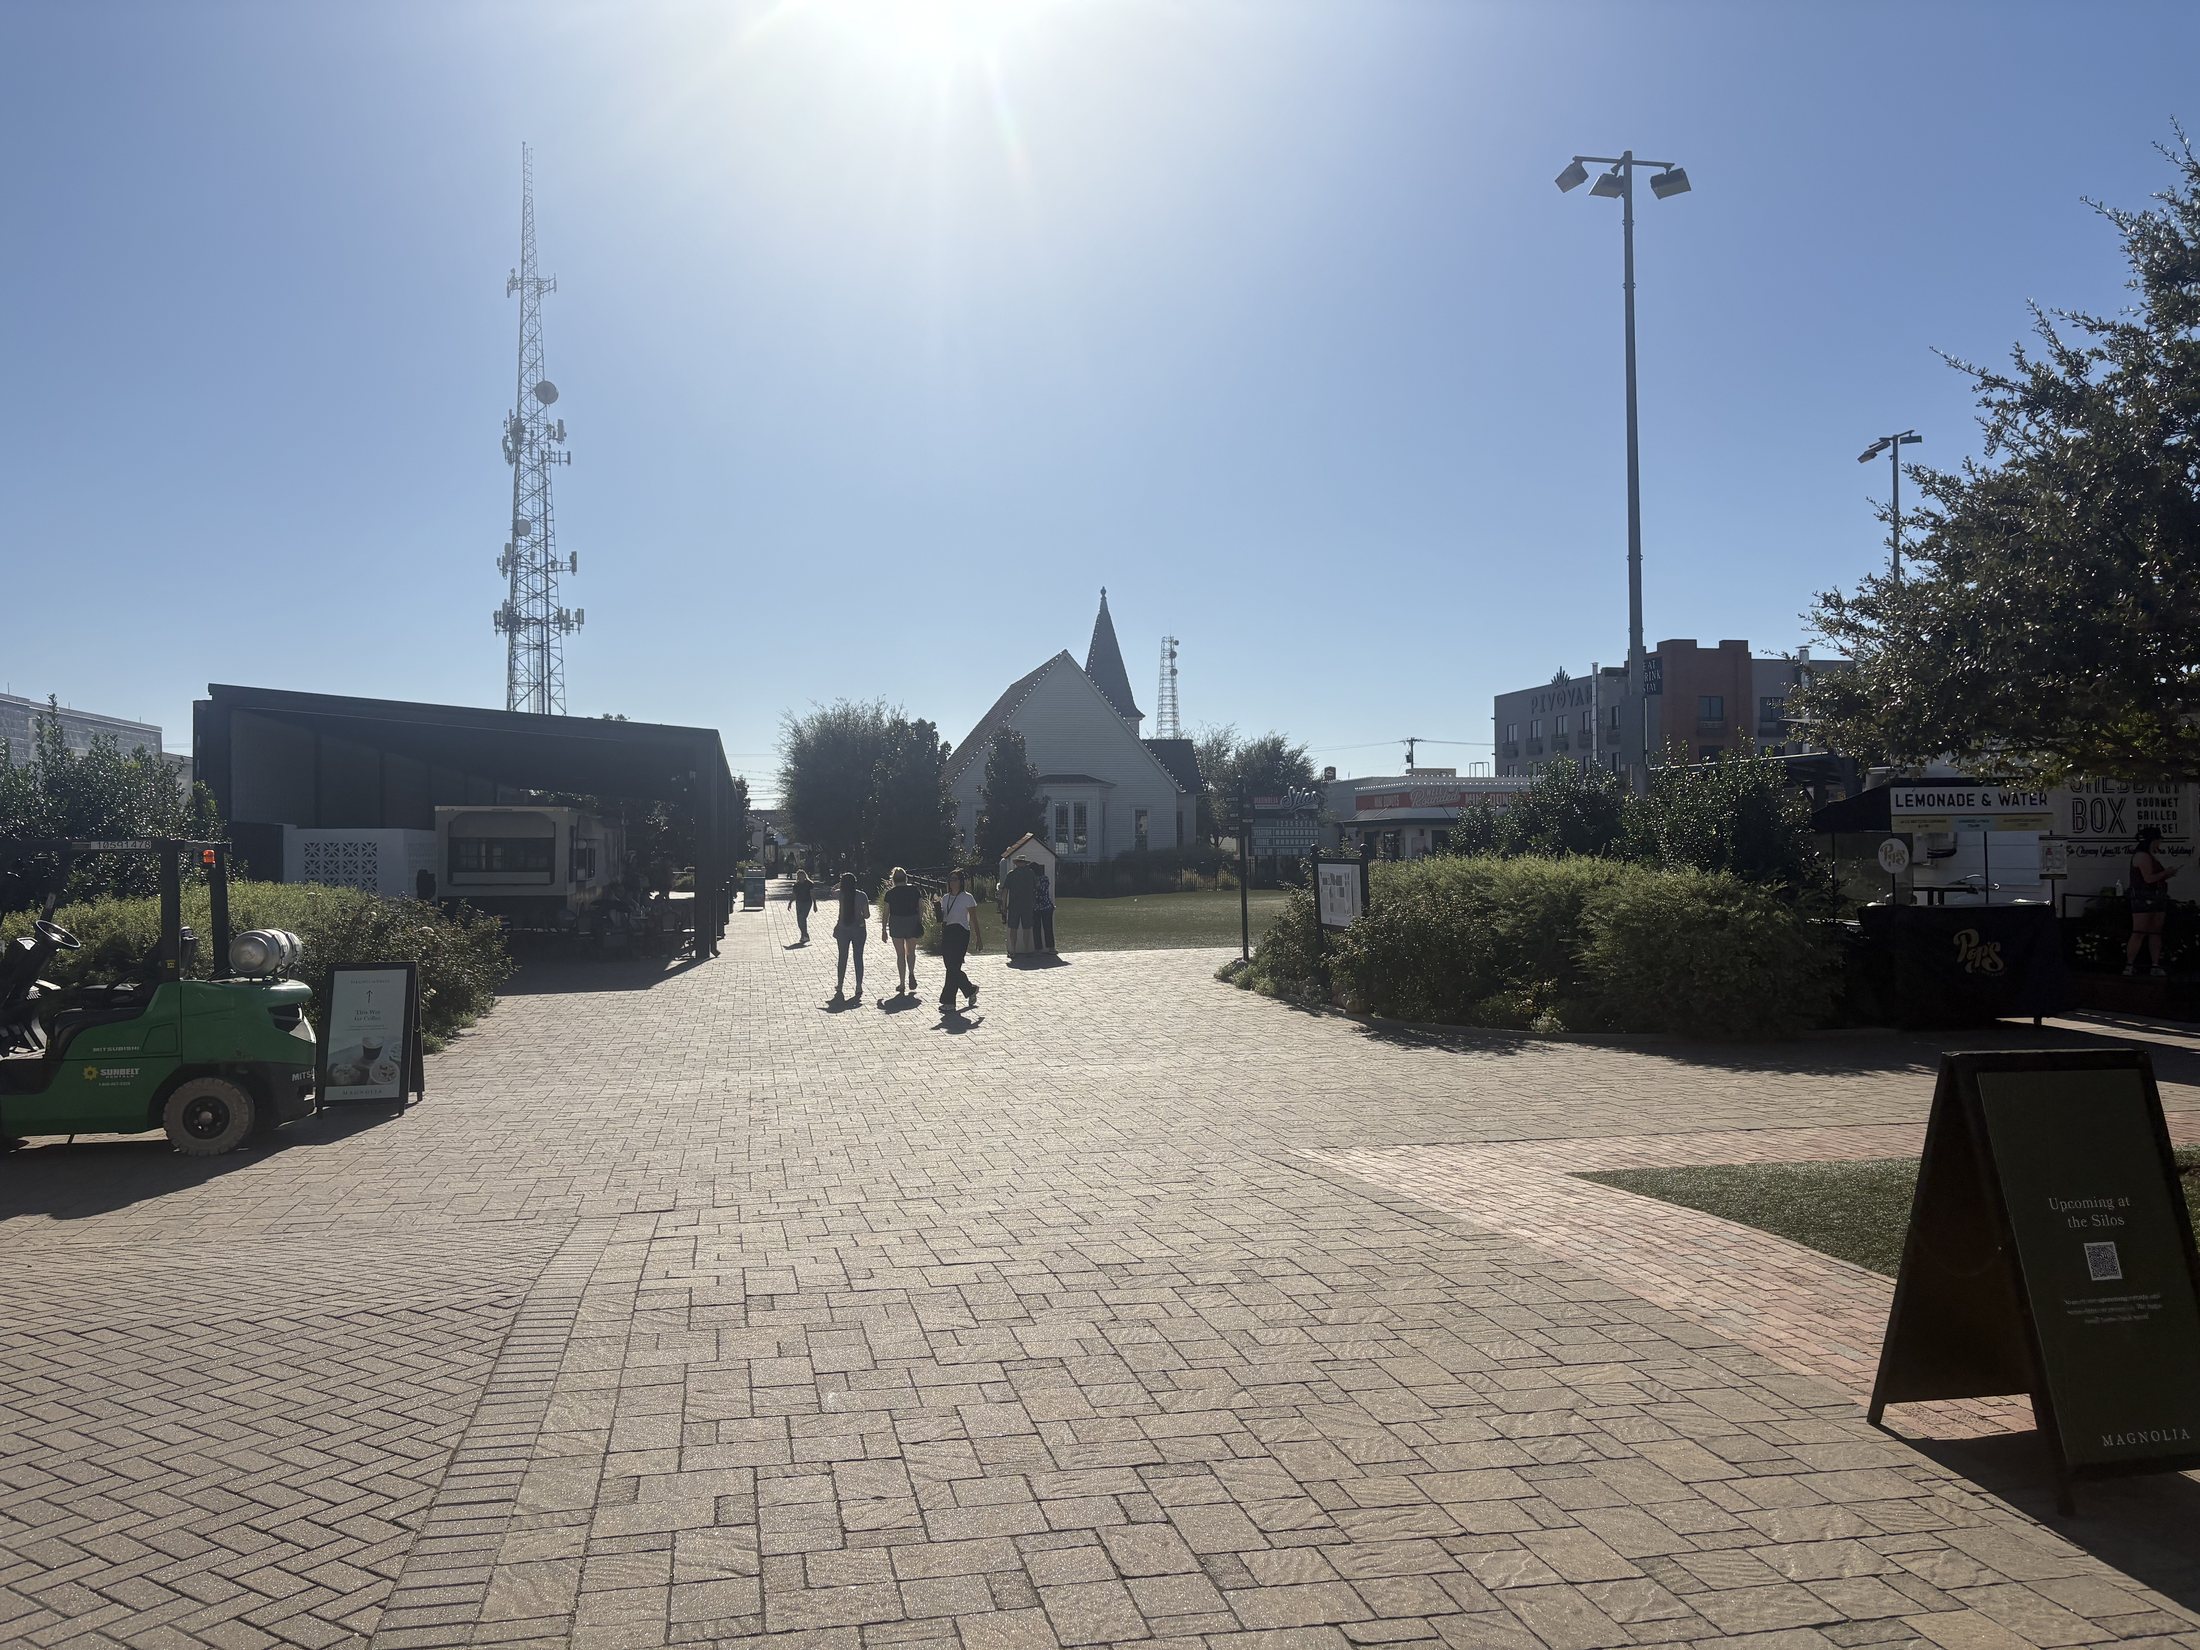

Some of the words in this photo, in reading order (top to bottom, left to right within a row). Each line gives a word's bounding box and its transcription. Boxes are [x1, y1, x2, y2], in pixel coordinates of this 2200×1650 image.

[1644, 670, 1661, 683] RINK
[1895, 793, 1974, 807] LEMONADE
[1981, 793, 1992, 806] &
[1998, 791, 2048, 806] WATER
[2136, 798, 2178, 807] GOURMET
[2072, 797, 2127, 834] BOX
[2137, 811, 2177, 821] GRILLED
[100, 1068, 140, 1076] SUNBELT
[2048, 1196, 2115, 1213] Upcoming
[2117, 1197, 2131, 1207] at
[2067, 1215, 2088, 1228] the
[2091, 1214, 2125, 1227] Silos
[2101, 1428, 2192, 1447] MAGNOLIA
